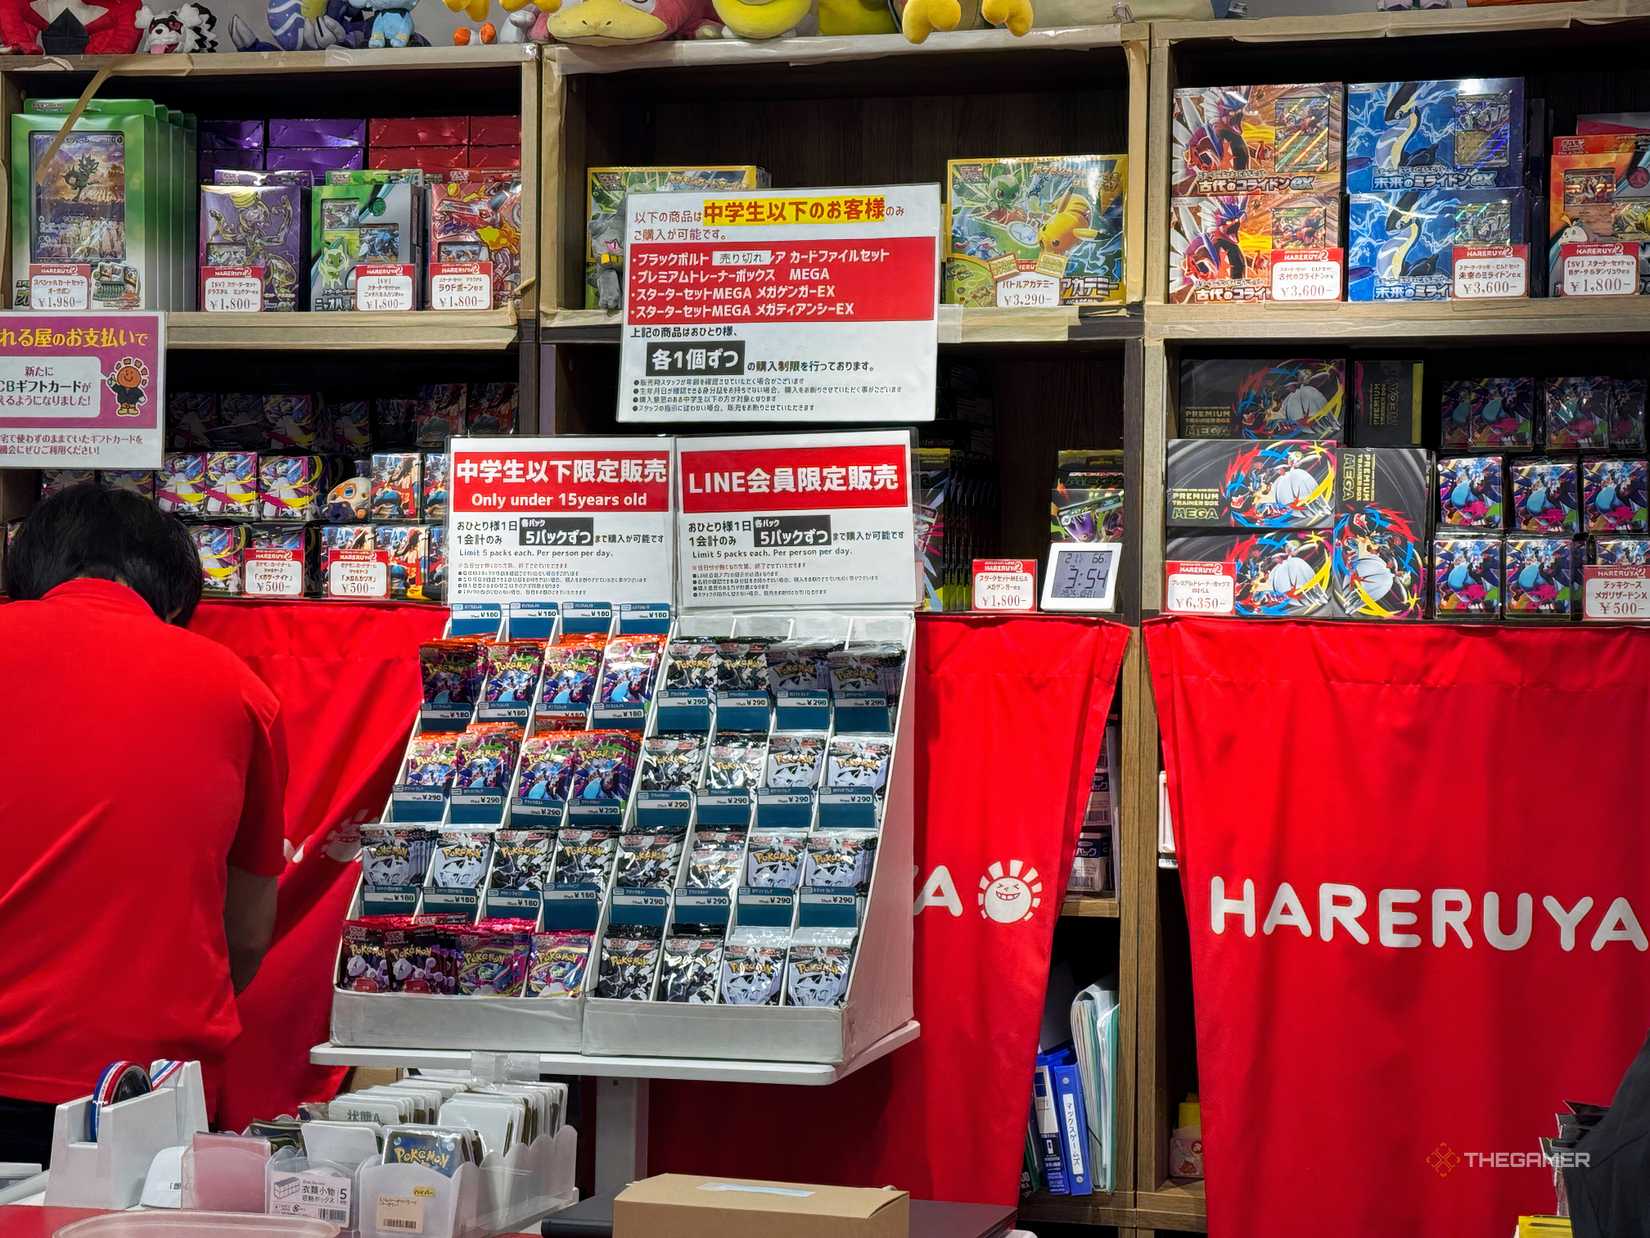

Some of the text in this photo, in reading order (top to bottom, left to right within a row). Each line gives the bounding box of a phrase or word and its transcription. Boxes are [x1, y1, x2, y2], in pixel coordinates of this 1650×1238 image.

[633, 228, 727, 241] ご購入が可能です。
[719, 252, 764, 264] 売り切れ
[790, 249, 889, 263] カードファイルセット
[638, 268, 830, 284] プレミアムトレーナーボックス MEGA
[636, 286, 752, 302] スターターセットMEGA
[635, 304, 752, 319] スターターセットMEGA
[652, 348, 739, 371] 各1個ずつ
[25, 366, 54, 377] 新たに
[457, 458, 667, 484] 中学生以下限定販売
[1342, 453, 1356, 501] MEGA
[688, 464, 899, 494] LINE会員限定販売
[471, 492, 647, 509] Only under 15years old
[1172, 507, 1219, 520] MEGA
[526, 530, 591, 545] 5パックずつ
[761, 530, 829, 545] 5パックずつ
[490, 549, 512, 558] packs
[552, 550, 579, 558] person
[581, 550, 594, 558] per
[692, 551, 715, 559] Limit
[724, 551, 747, 560] packs
[789, 549, 817, 558] person
[819, 549, 832, 557] per
[1065, 568, 1109, 589] 3:54
[1210, 875, 1650, 952] HARERUYA
[340, 1188, 347, 1200] 5
